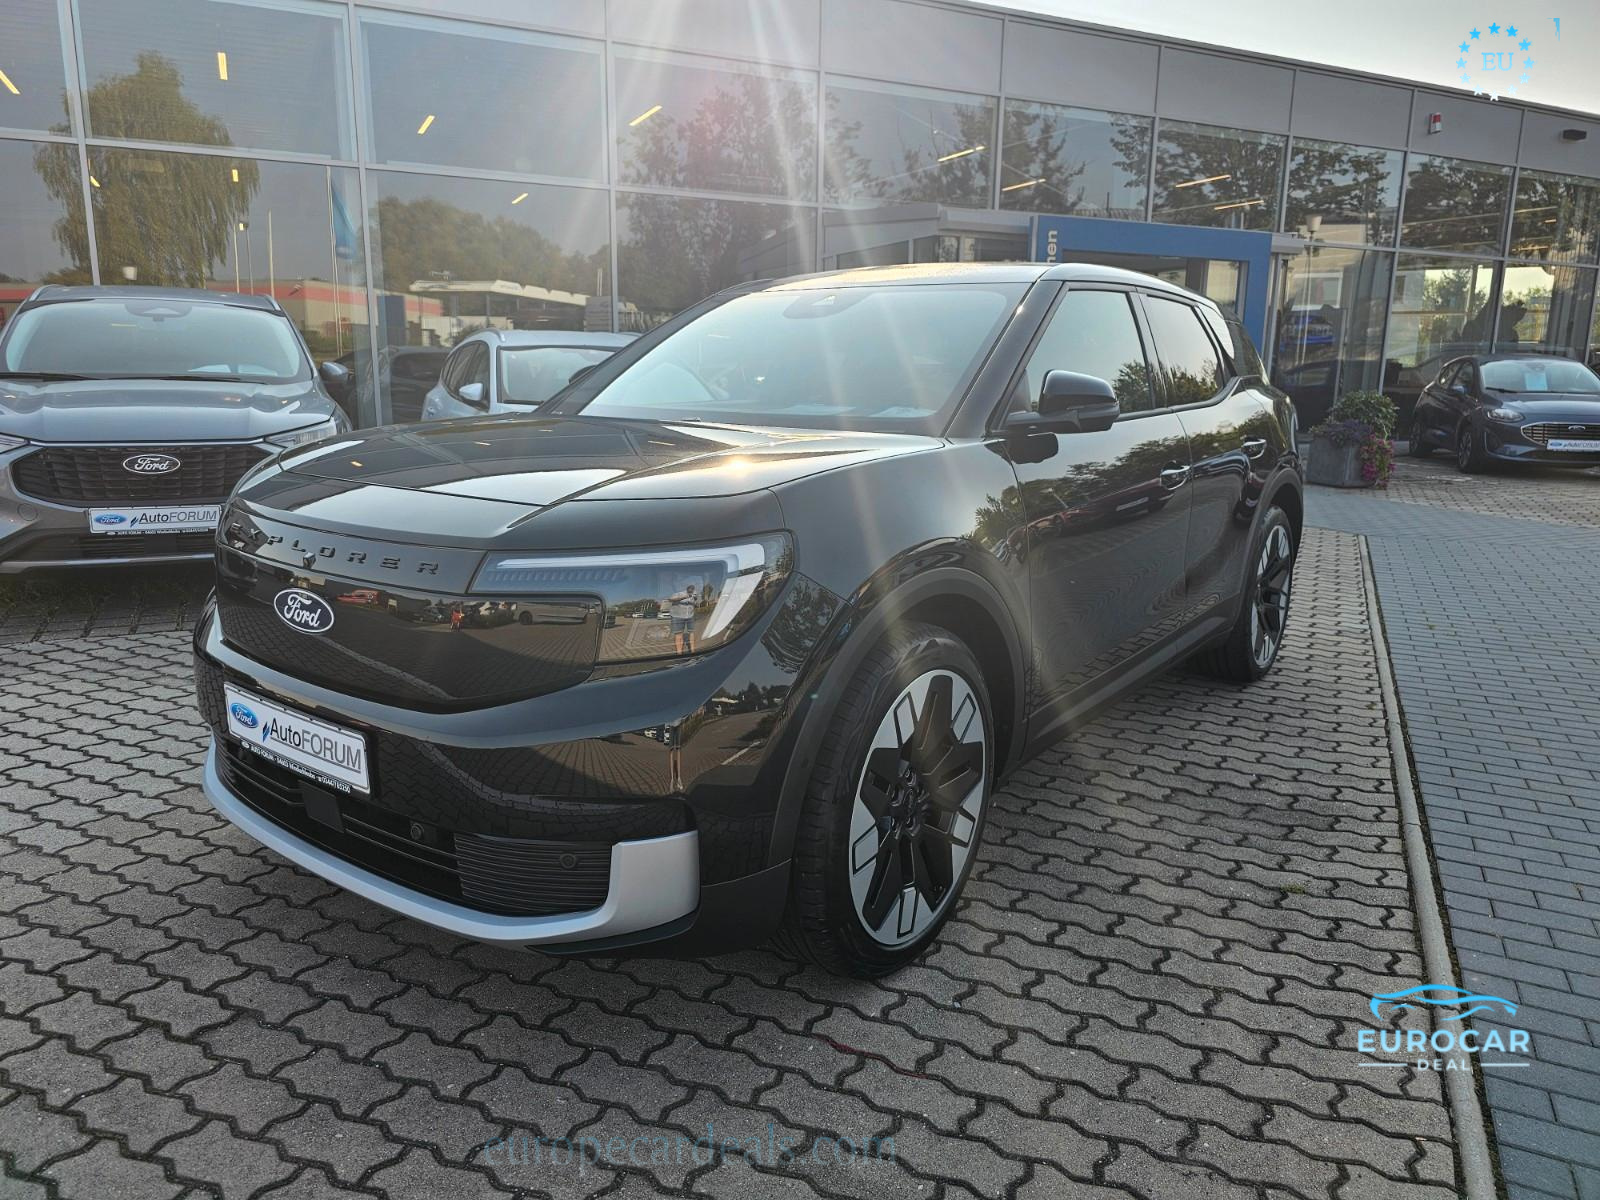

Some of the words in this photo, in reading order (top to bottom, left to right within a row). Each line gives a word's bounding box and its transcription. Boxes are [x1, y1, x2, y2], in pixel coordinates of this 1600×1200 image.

[134, 457, 170, 470] Ford
[139, 511, 217, 524] AutoFORUM
[231, 521, 440, 576] EXPLORER
[283, 593, 322, 628] Ford
[270, 717, 362, 770] AutoFORUM
